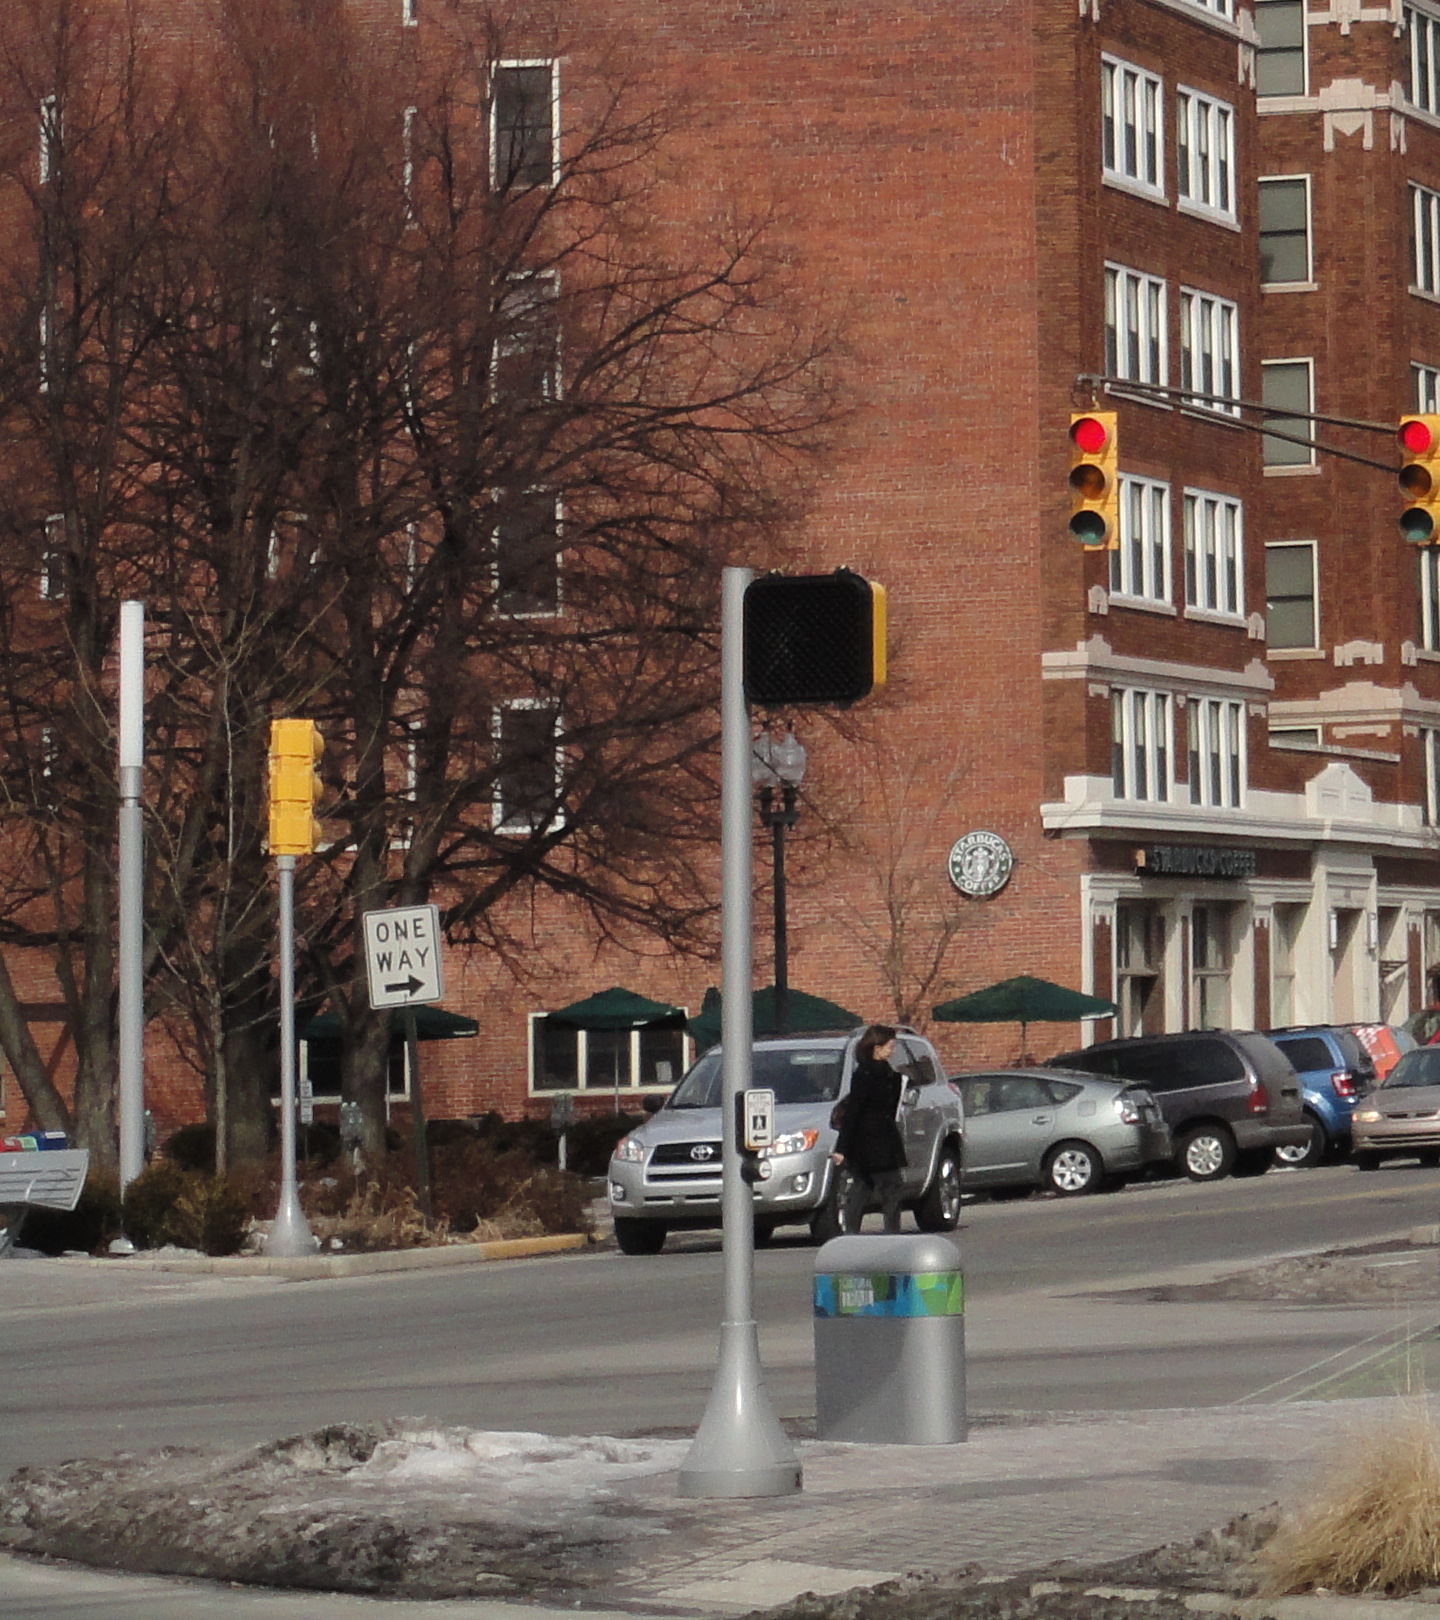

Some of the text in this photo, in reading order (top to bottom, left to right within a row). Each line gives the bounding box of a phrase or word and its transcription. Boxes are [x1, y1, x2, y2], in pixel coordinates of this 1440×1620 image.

[952, 834, 1008, 862] STARBUCKS
[957, 874, 1001, 892] COFFEE
[375, 917, 427, 943] ONE
[375, 946, 430, 973] WAY
